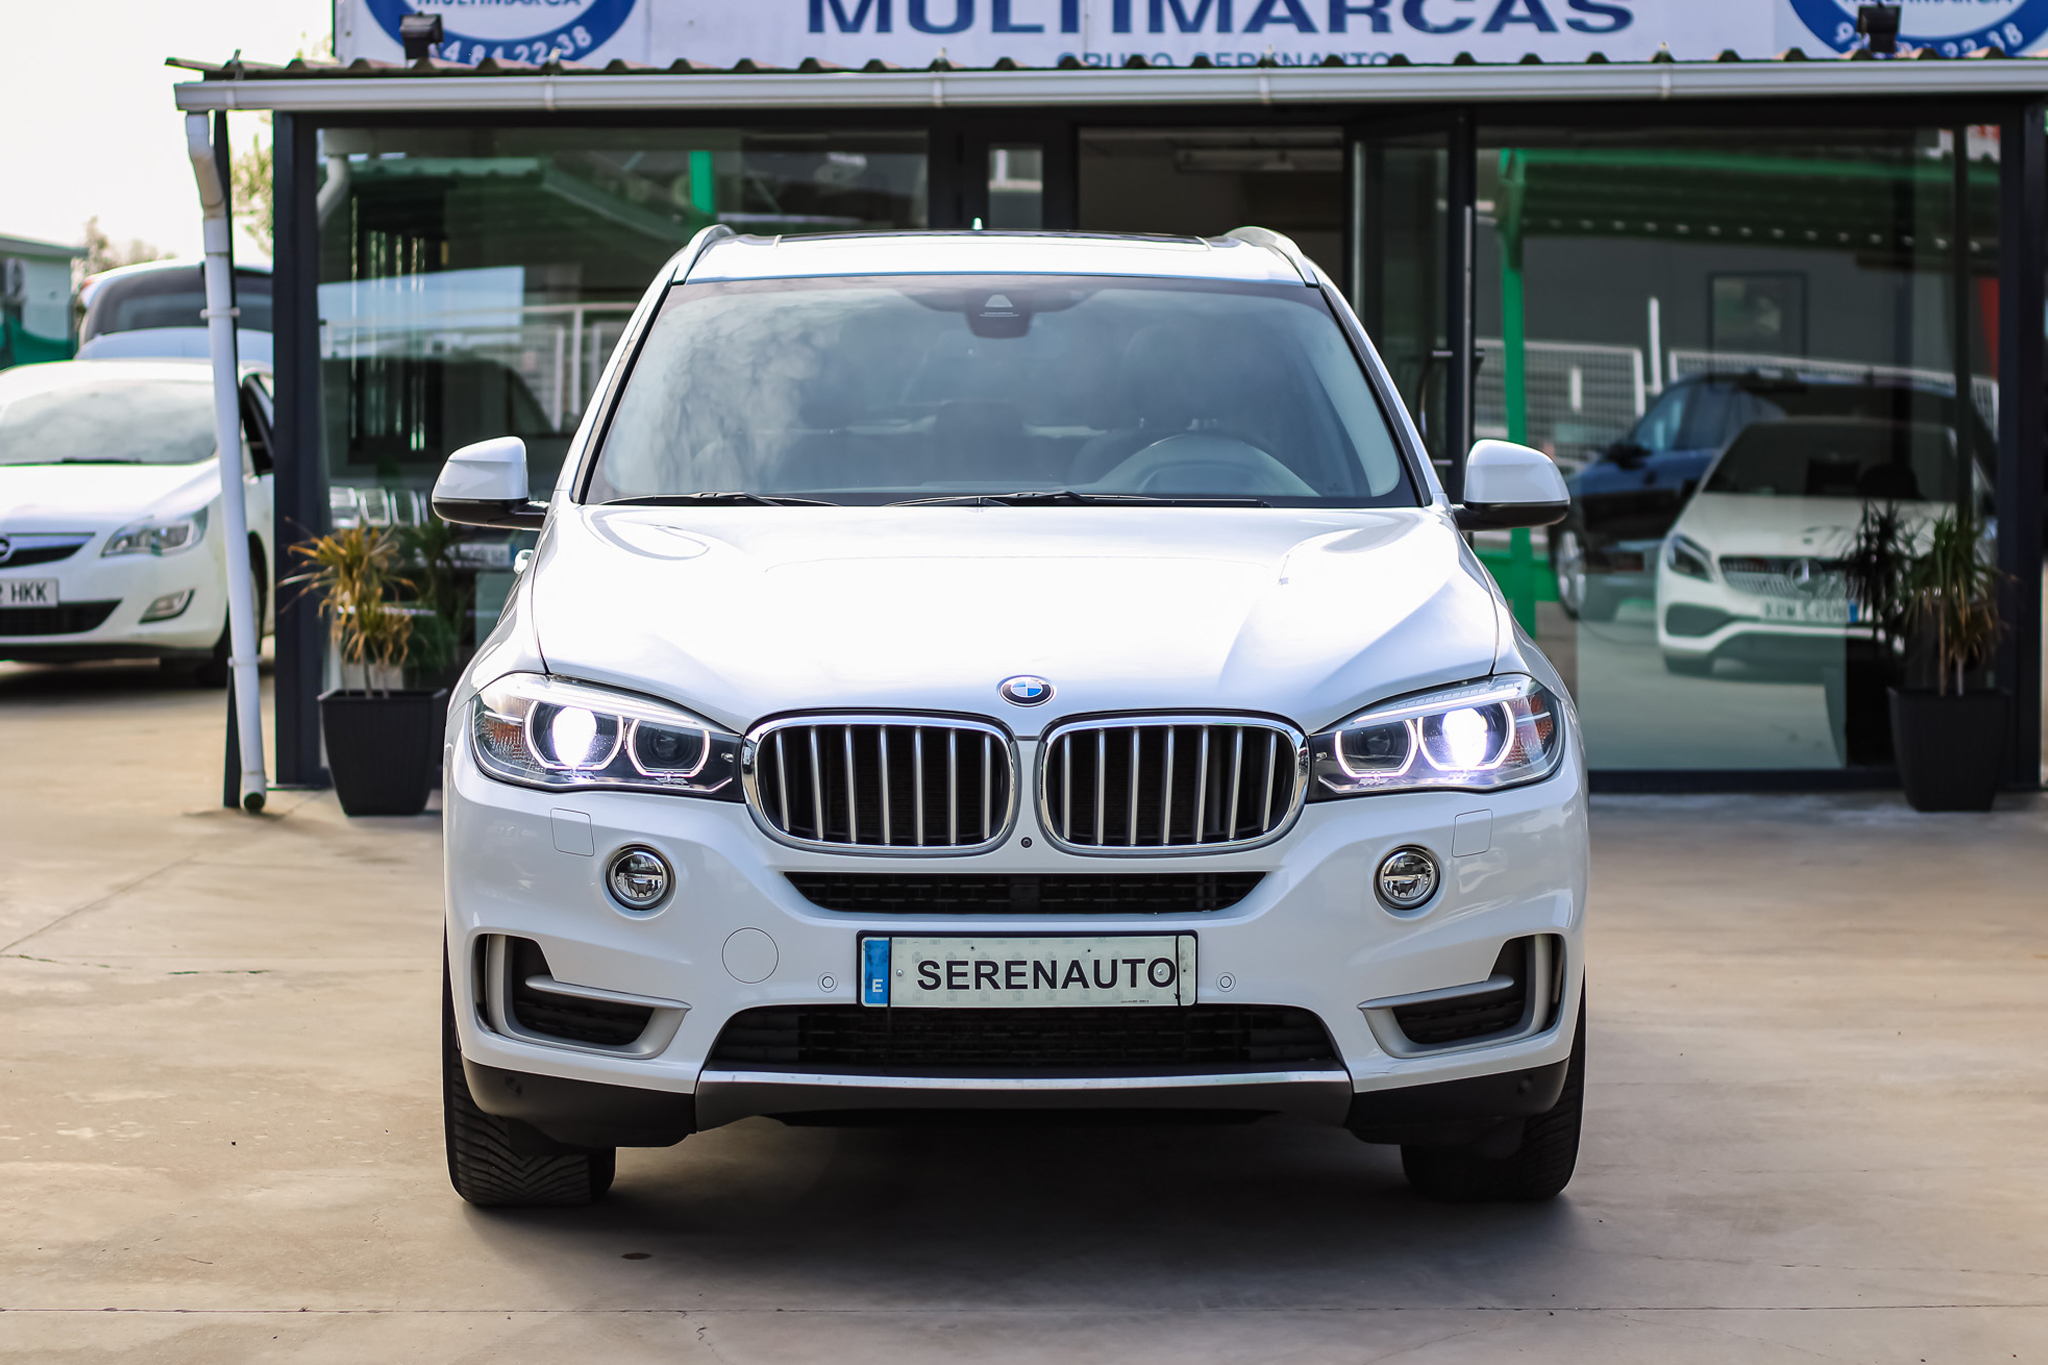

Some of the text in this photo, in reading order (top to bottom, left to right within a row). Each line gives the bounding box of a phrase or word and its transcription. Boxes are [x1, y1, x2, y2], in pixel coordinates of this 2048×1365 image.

[807, 0, 1635, 34] MULTIMARCAS
[11, 582, 47, 602] HKK
[872, 979, 884, 993] E
[917, 958, 1177, 991] SERENAUTO
